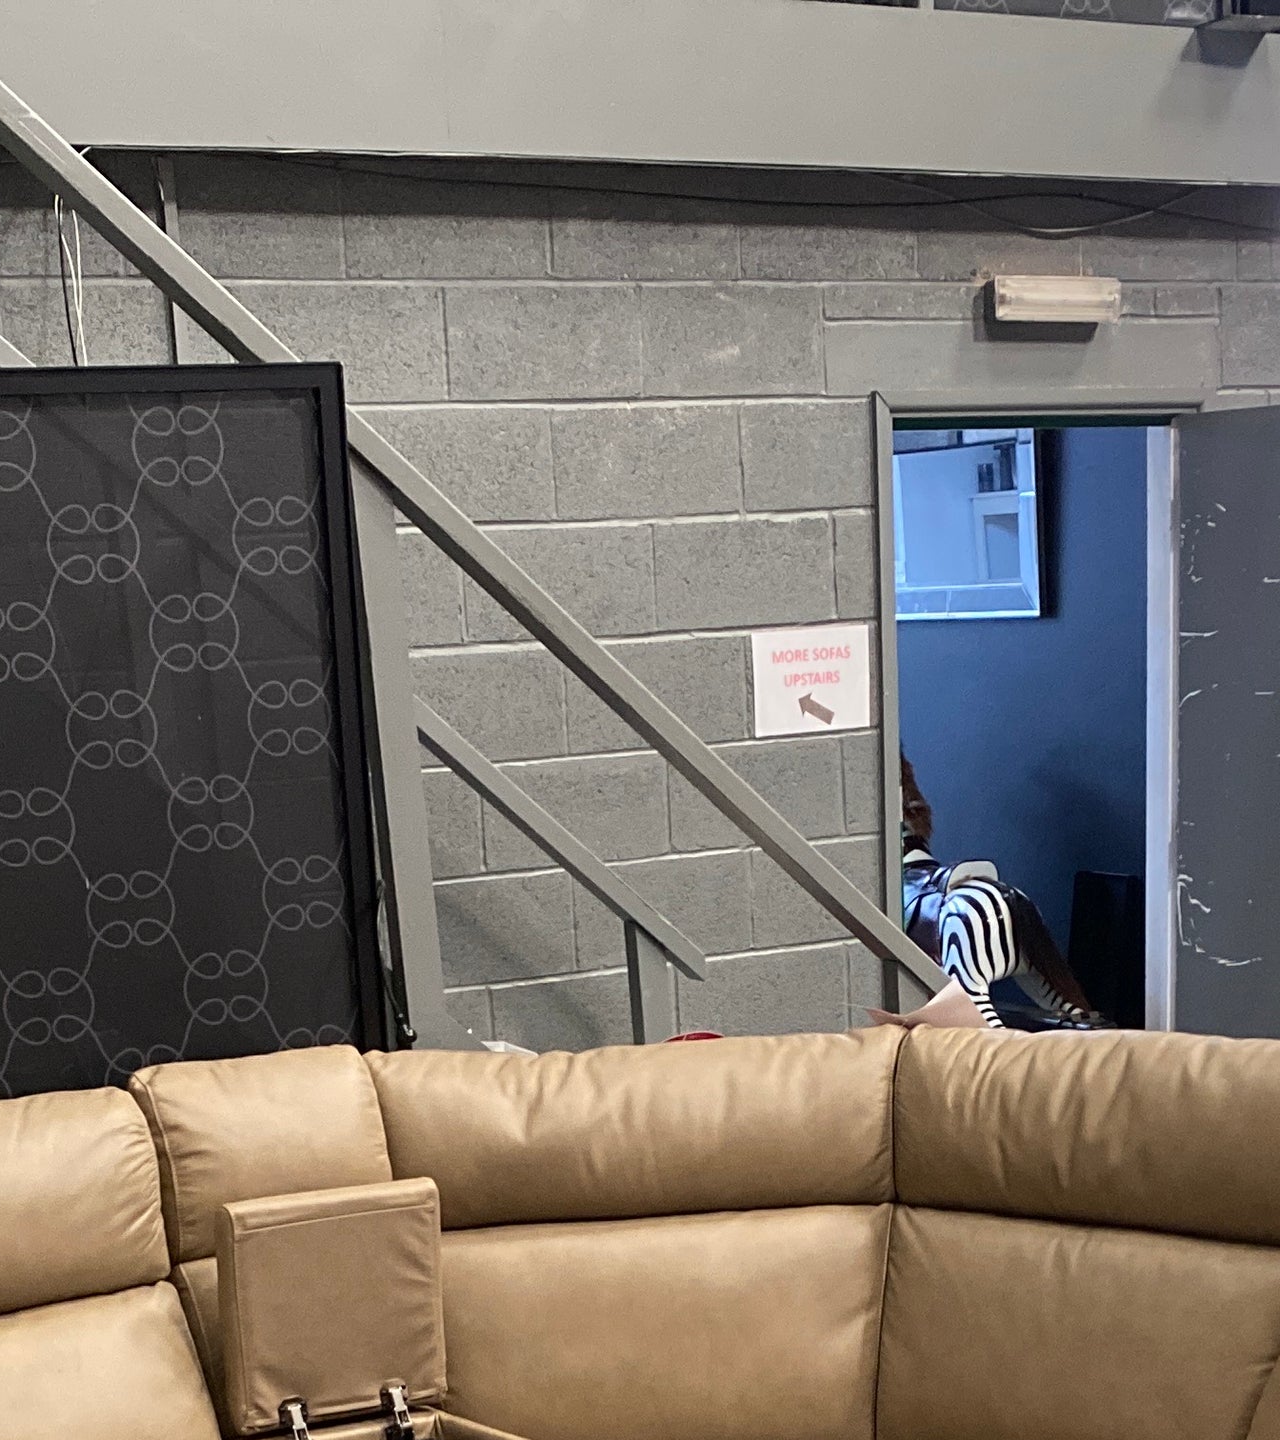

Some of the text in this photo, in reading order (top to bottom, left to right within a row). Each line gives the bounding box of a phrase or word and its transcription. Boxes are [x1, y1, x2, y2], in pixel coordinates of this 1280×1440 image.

[772, 646, 851, 664] MORE SOFAS
[783, 671, 840, 687] UPSTAIRS
